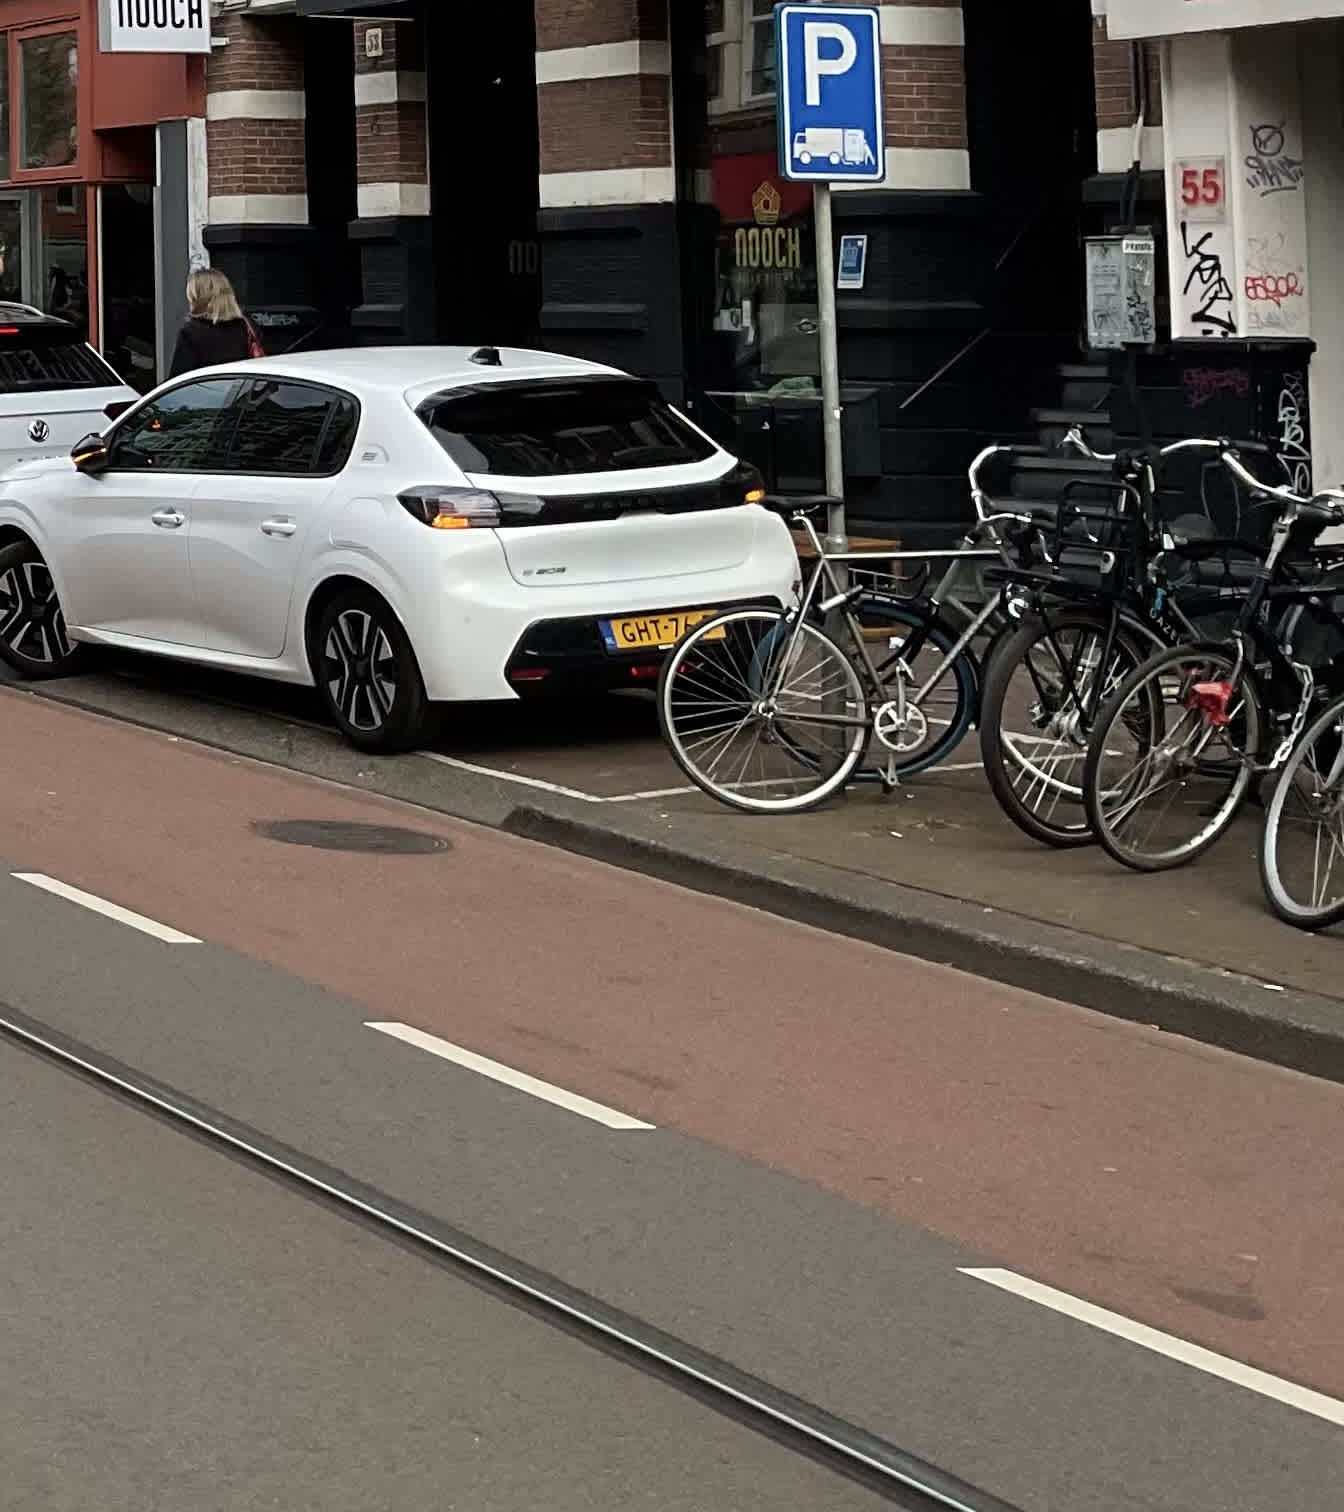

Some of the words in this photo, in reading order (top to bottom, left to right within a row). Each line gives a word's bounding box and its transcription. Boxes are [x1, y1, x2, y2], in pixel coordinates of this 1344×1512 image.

[804, 21, 857, 106] P
[1181, 168, 1219, 206] 55
[734, 227, 801, 269] NOOCH
